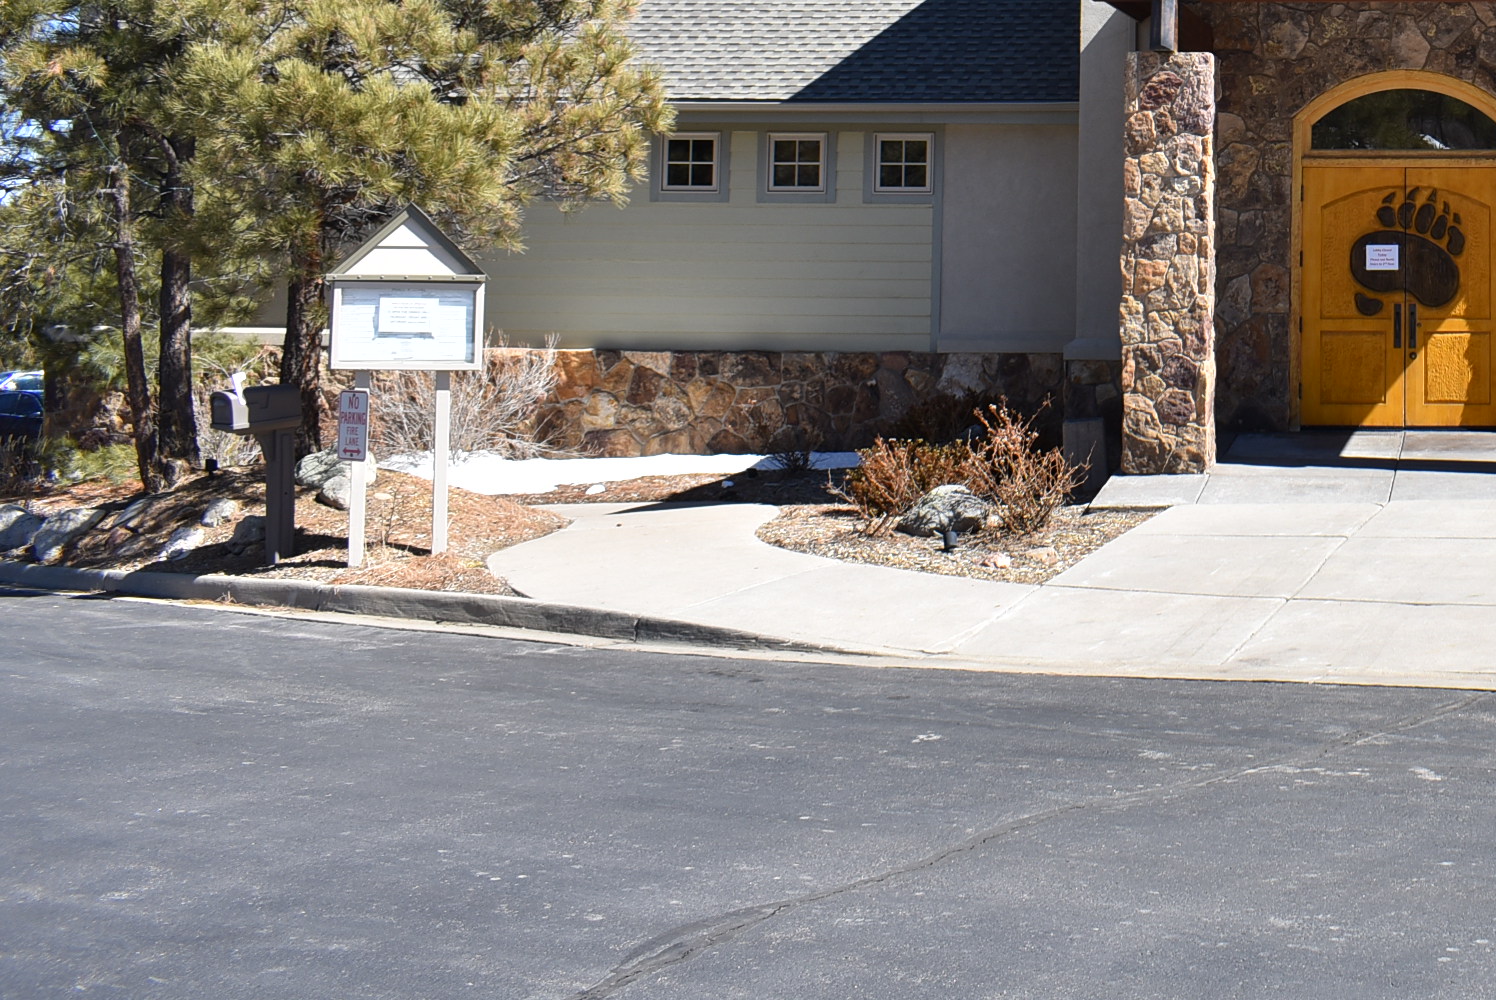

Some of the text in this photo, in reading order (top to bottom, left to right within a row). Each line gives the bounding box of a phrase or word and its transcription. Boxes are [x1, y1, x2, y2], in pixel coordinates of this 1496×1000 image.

[348, 396, 360, 409] NO
[340, 411, 366, 426] PARKING
[346, 426, 359, 436] FIRE
[345, 437, 359, 446] LANE
